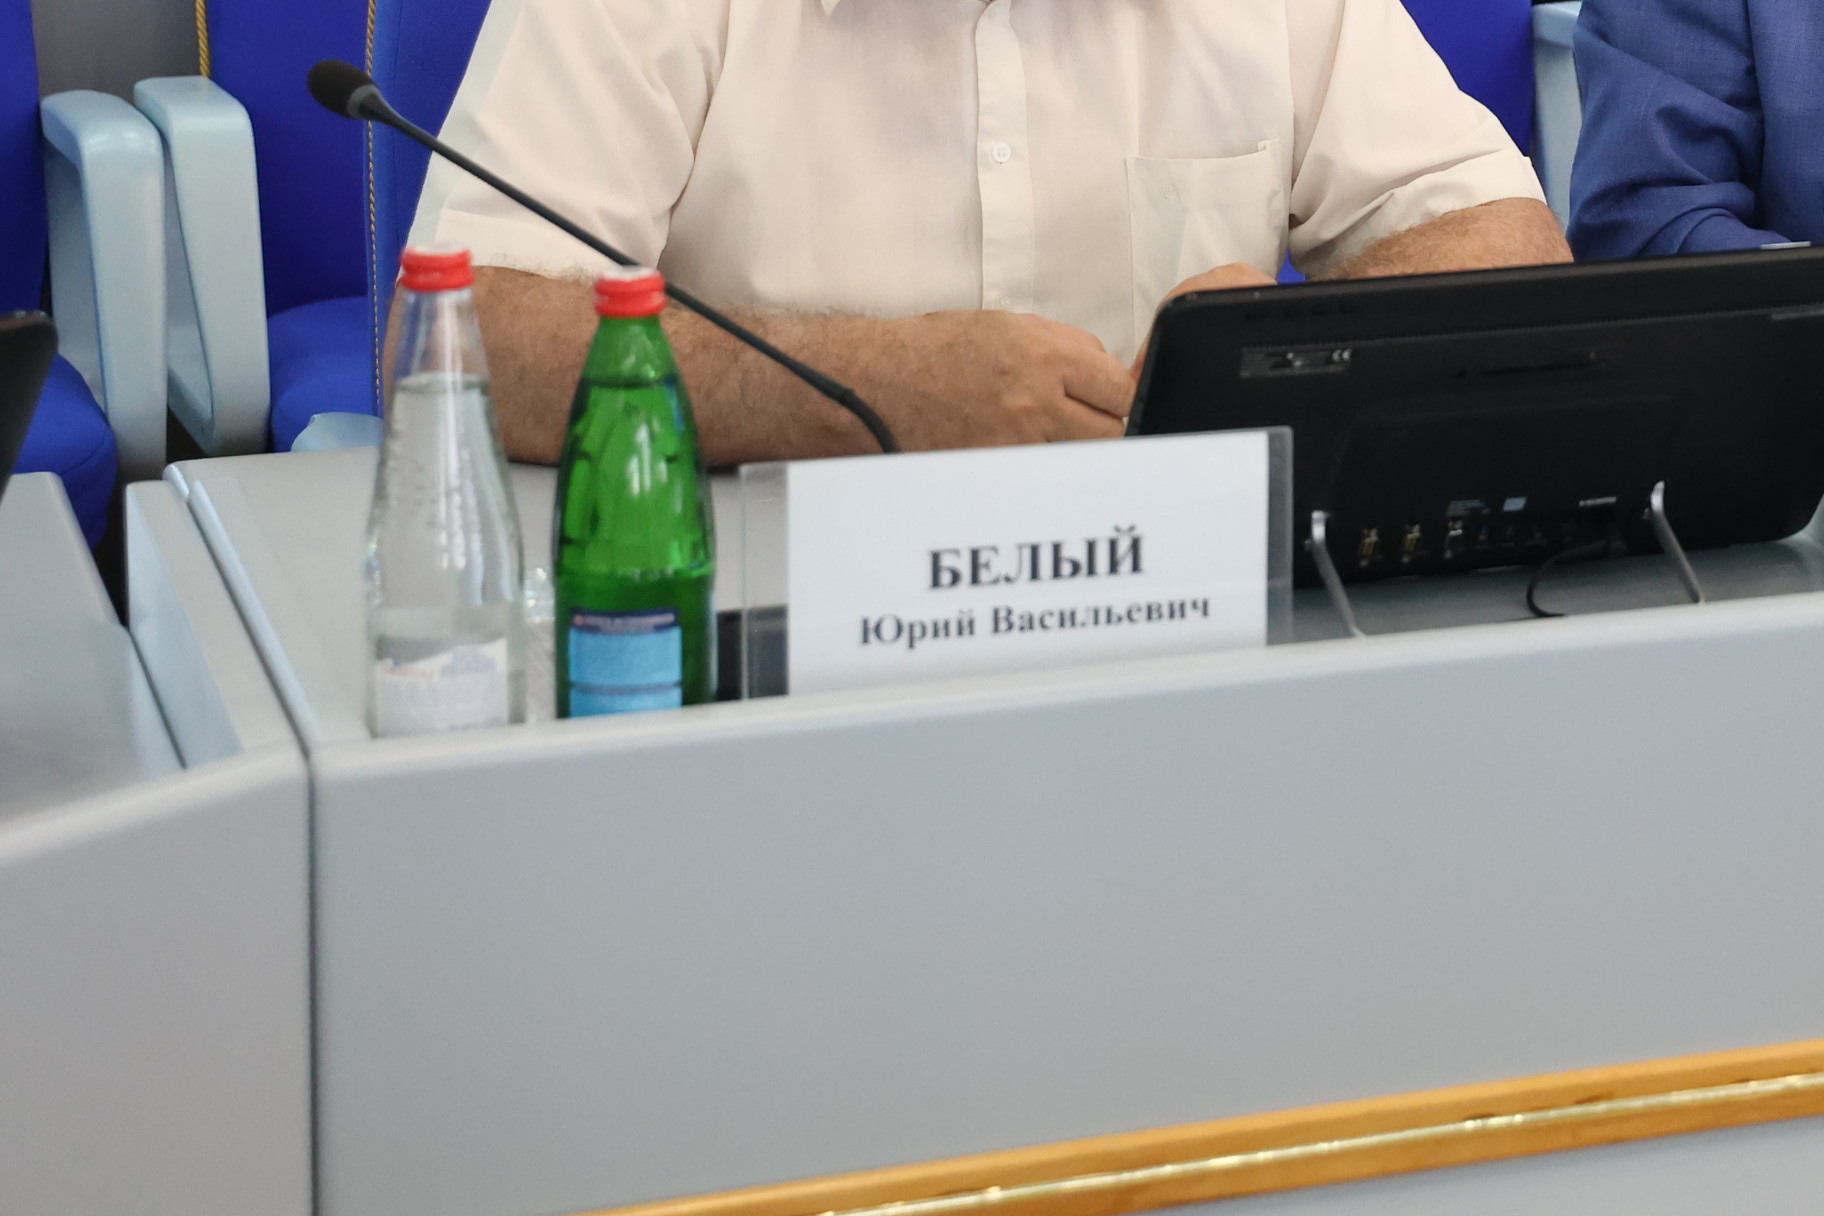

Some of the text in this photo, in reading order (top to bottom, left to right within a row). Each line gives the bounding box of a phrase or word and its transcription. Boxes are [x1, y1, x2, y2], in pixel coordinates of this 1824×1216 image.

[927, 524, 1144, 591] БЕЛЫЙ
[858, 597, 1211, 651] Юрий Васильевич
